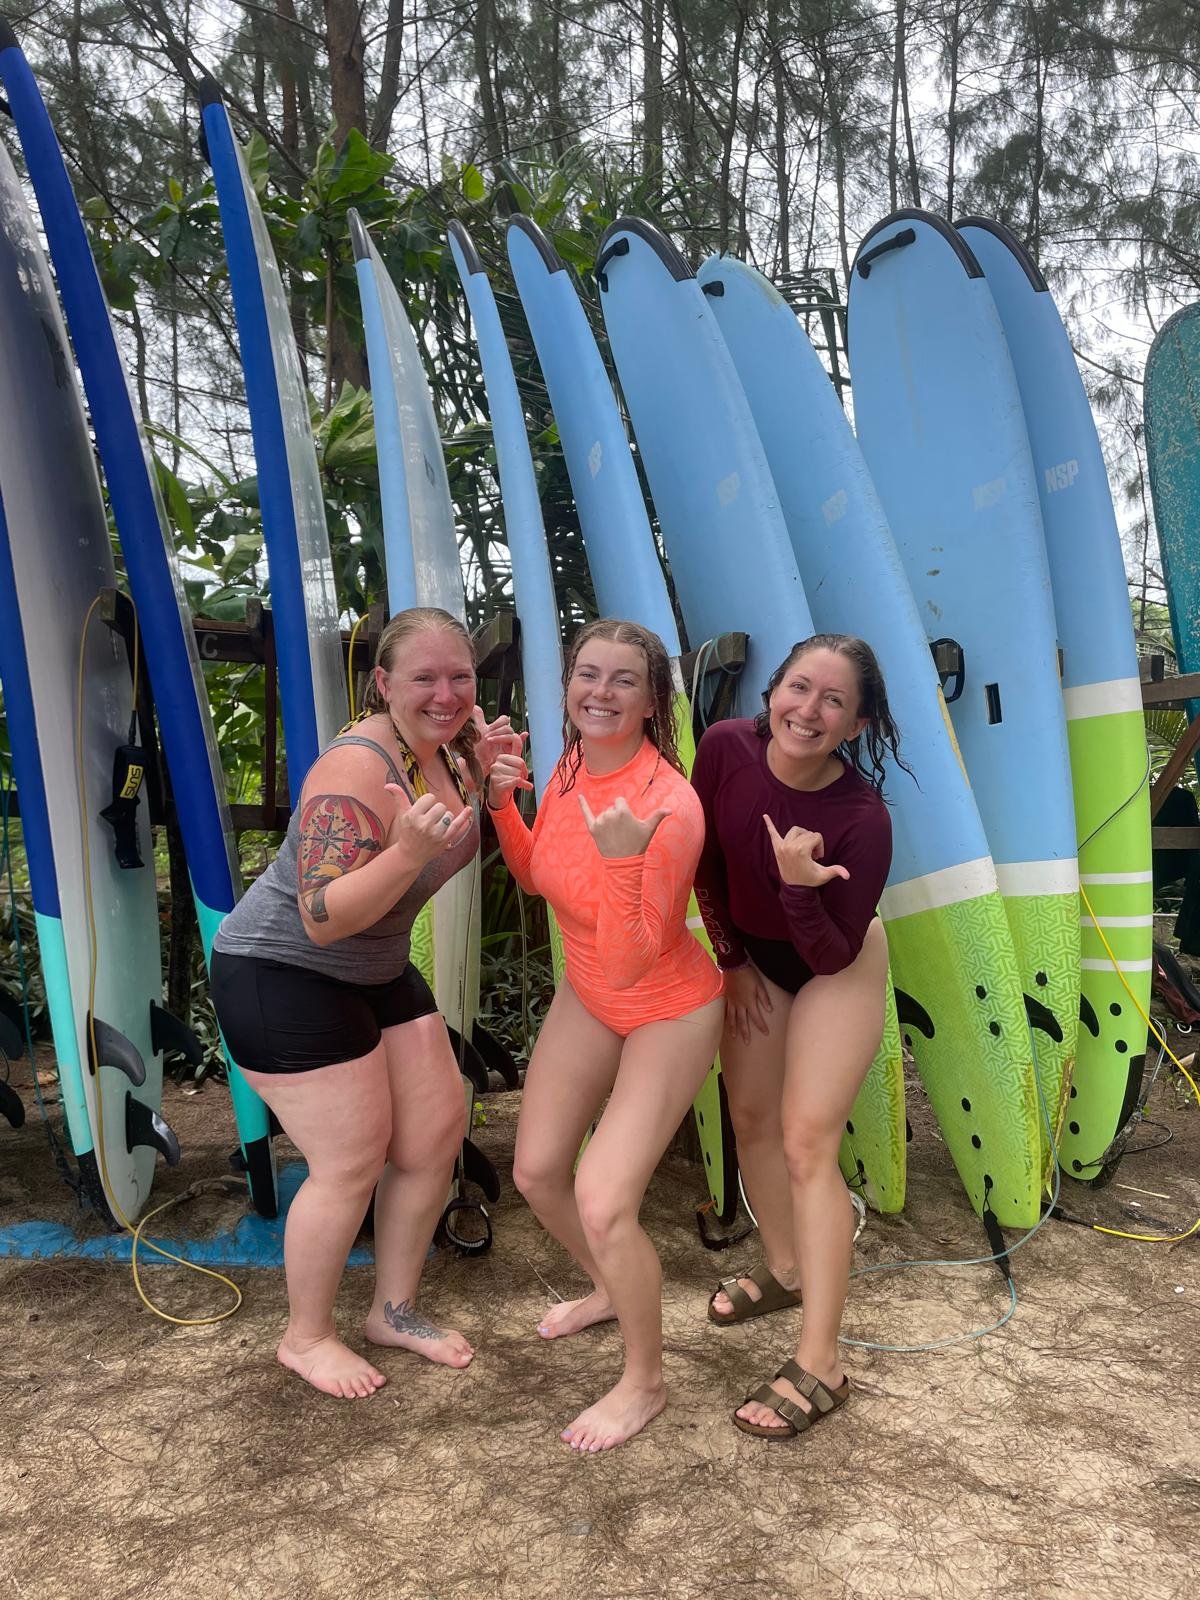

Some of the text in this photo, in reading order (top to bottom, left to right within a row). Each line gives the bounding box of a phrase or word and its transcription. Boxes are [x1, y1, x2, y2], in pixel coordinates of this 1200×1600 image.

[1045, 459, 1079, 493] NSP
[201, 633, 218, 658] C
[125, 767, 141, 797] SUNS
